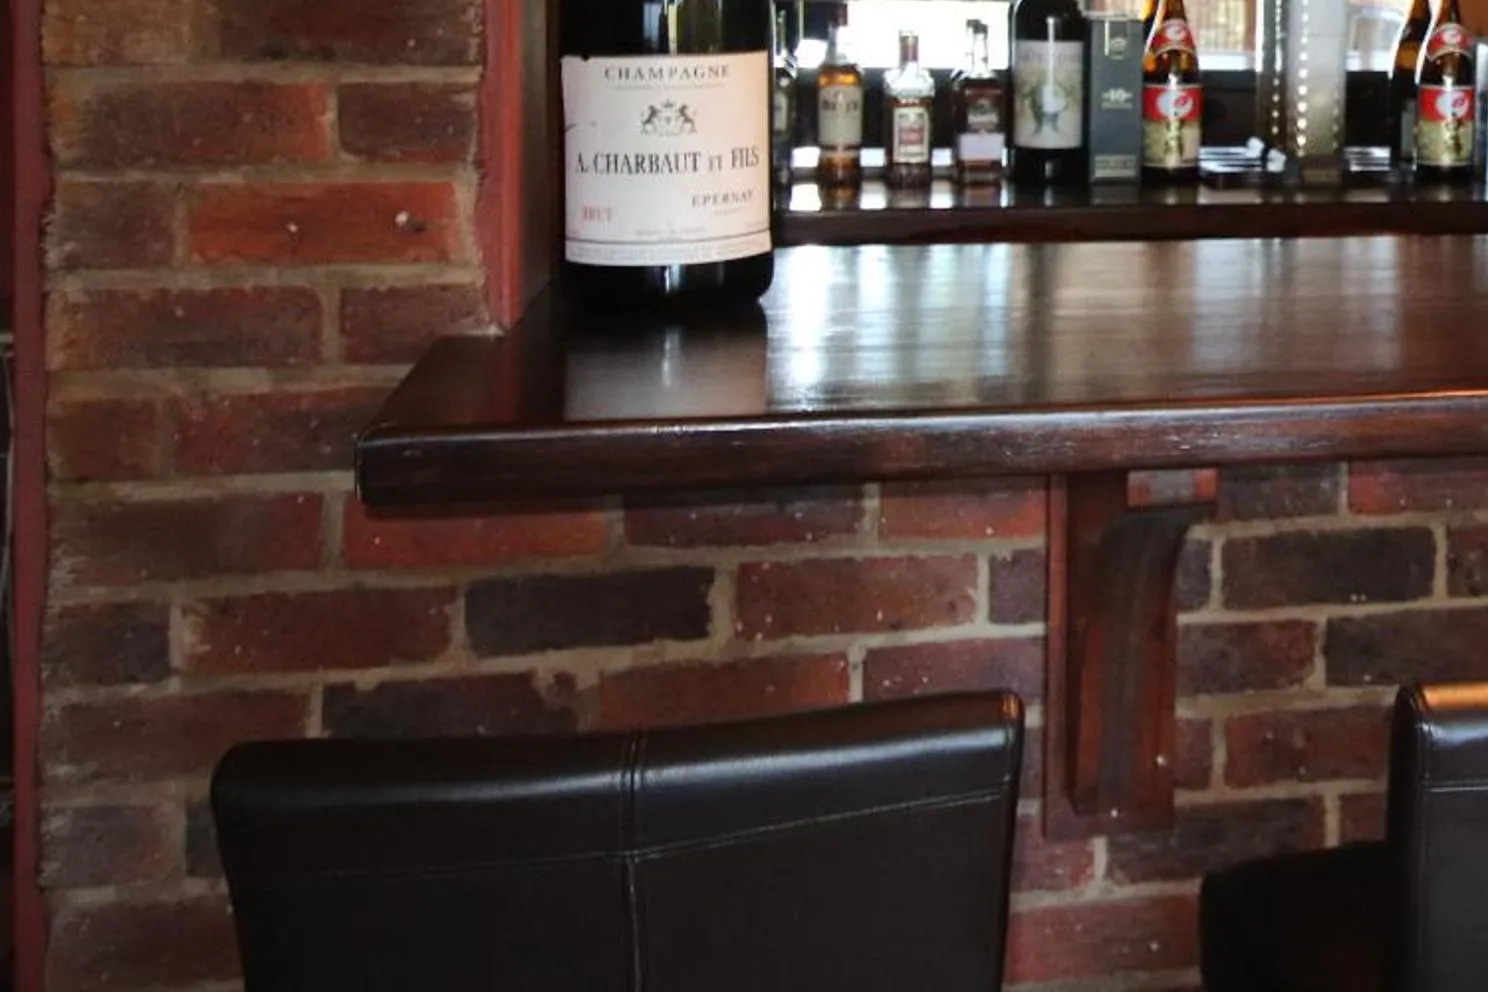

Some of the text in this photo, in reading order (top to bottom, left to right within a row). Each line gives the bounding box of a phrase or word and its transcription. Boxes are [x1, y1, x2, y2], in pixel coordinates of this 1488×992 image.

[604, 64, 731, 81] CHAMPAGNE
[593, 151, 701, 175] CHARBAUT
[731, 146, 759, 169] FILS
[692, 190, 753, 207] EPERNAY
